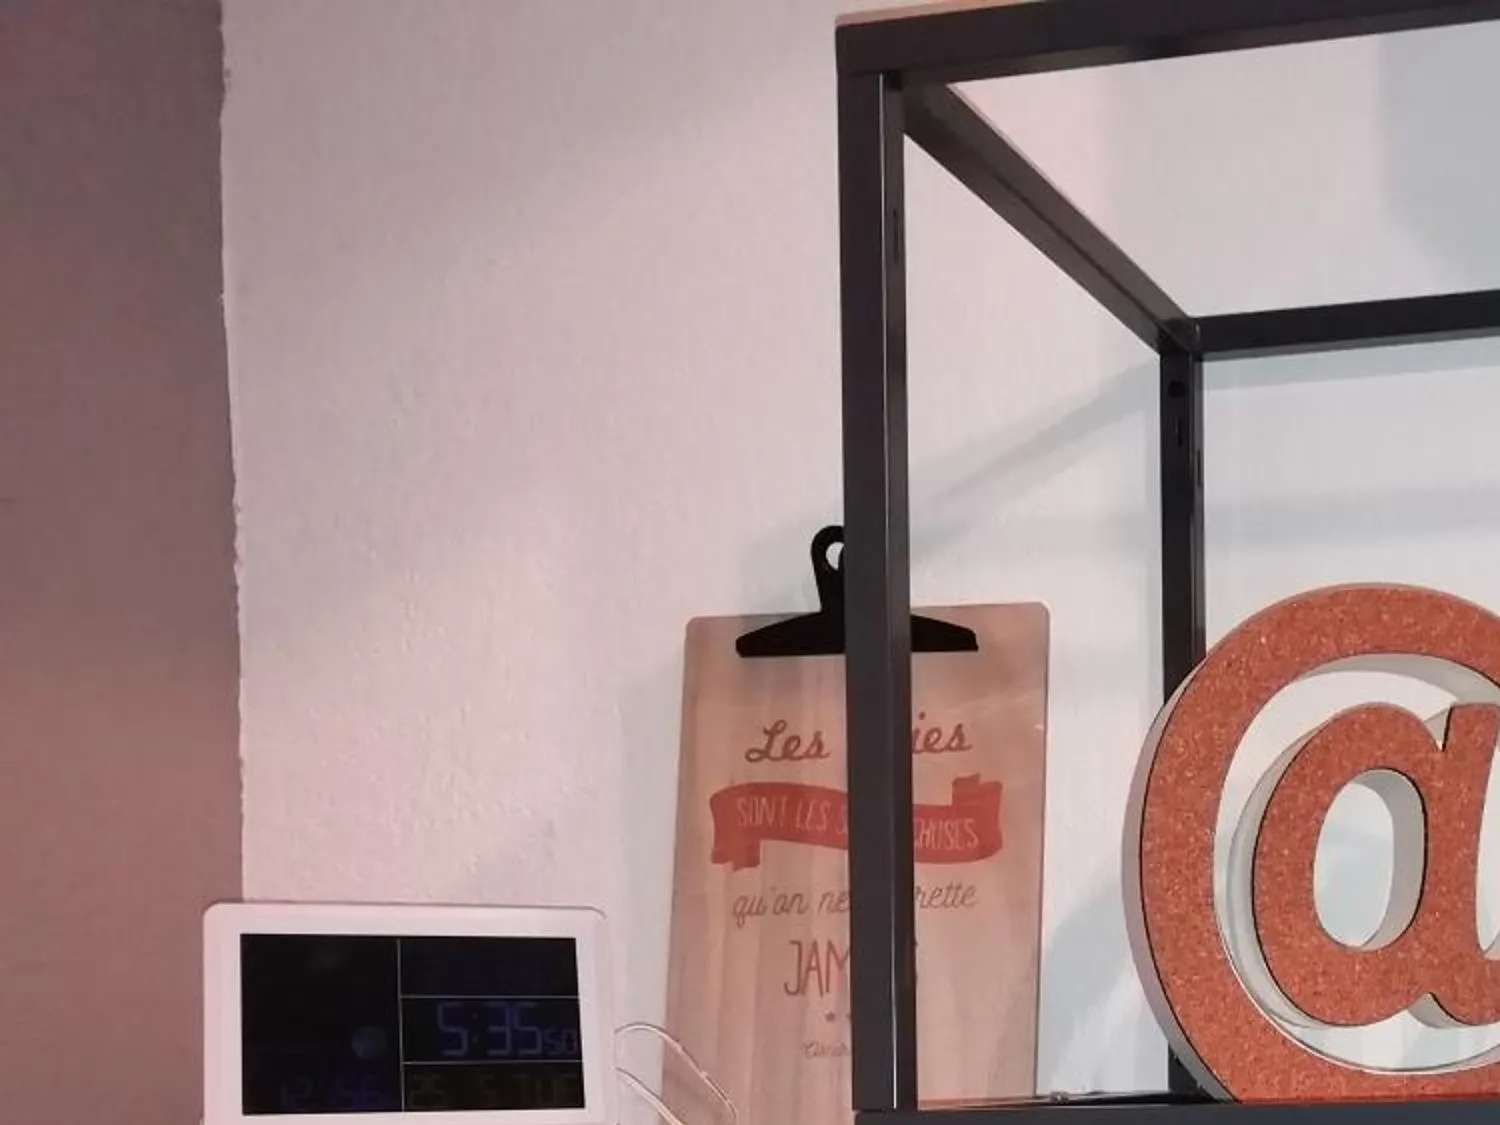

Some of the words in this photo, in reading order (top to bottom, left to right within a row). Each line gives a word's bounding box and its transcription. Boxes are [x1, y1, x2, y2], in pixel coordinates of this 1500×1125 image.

[744, 718, 831, 763] Les
[910, 710, 974, 754] ies
[732, 885, 809, 929] qu'on
[914, 880, 979, 909] rette
[783, 939, 850, 998] JAM
